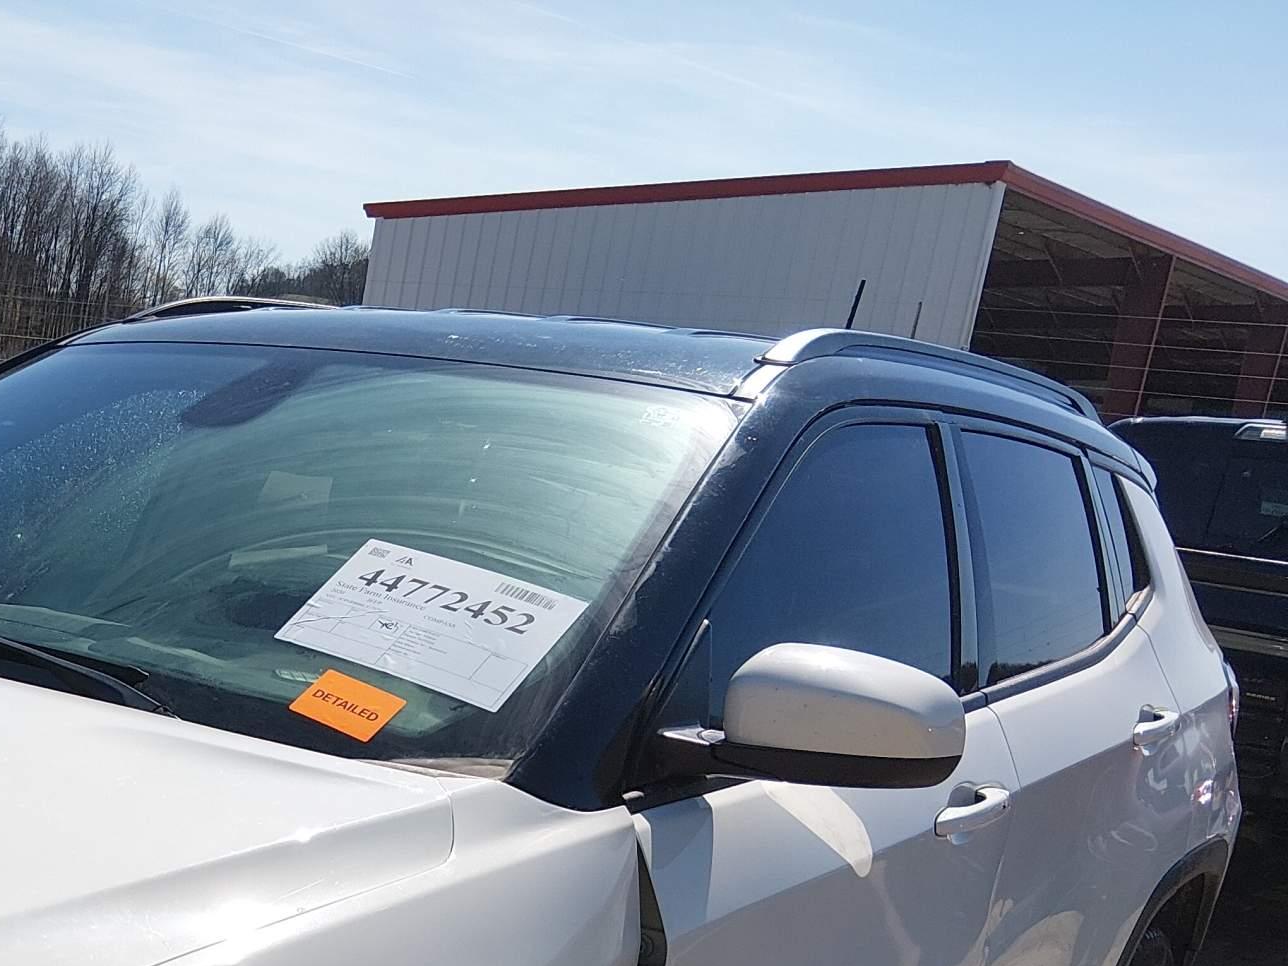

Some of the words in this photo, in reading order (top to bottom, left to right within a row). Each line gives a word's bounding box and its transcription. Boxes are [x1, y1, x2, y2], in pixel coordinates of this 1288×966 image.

[336, 581, 358, 591] State
[359, 587, 382, 599] Farm
[383, 593, 426, 611] Insurance
[358, 569, 535, 635] 44772452
[312, 689, 379, 722] DETAILED
